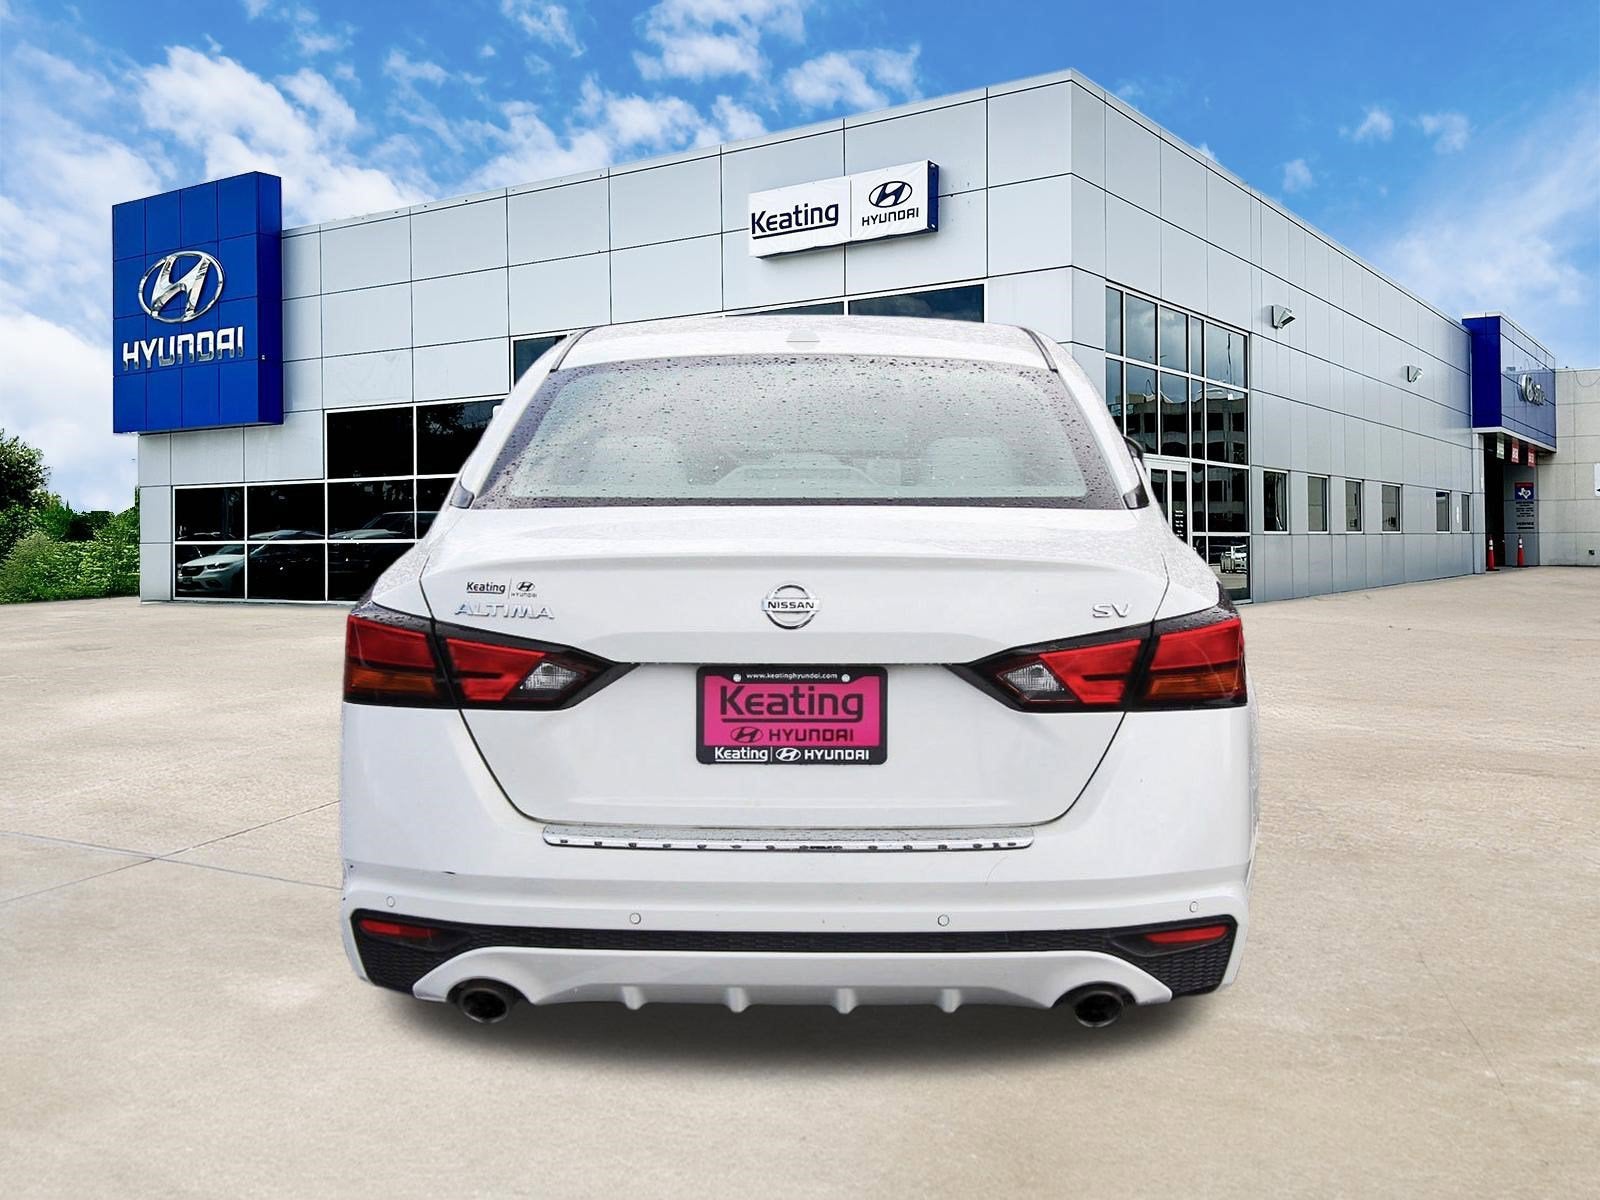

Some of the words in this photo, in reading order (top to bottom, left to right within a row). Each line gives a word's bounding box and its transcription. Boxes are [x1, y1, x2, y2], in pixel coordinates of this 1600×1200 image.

[751, 203, 839, 239] Keating
[861, 207, 919, 226] HYUNDAI
[123, 326, 244, 371] HYUNDAI
[466, 582, 506, 594] Keating
[454, 603, 555, 620] ALTIMA
[767, 601, 815, 609] NISSAN
[1092, 603, 1129, 618] SV
[746, 672, 838, 680] www.keatinghyundai.com
[720, 685, 864, 723] Keating
[769, 728, 853, 742] HYUNDAI
[714, 747, 769, 762] Keating
[804, 750, 869, 761] HYUNDAI
